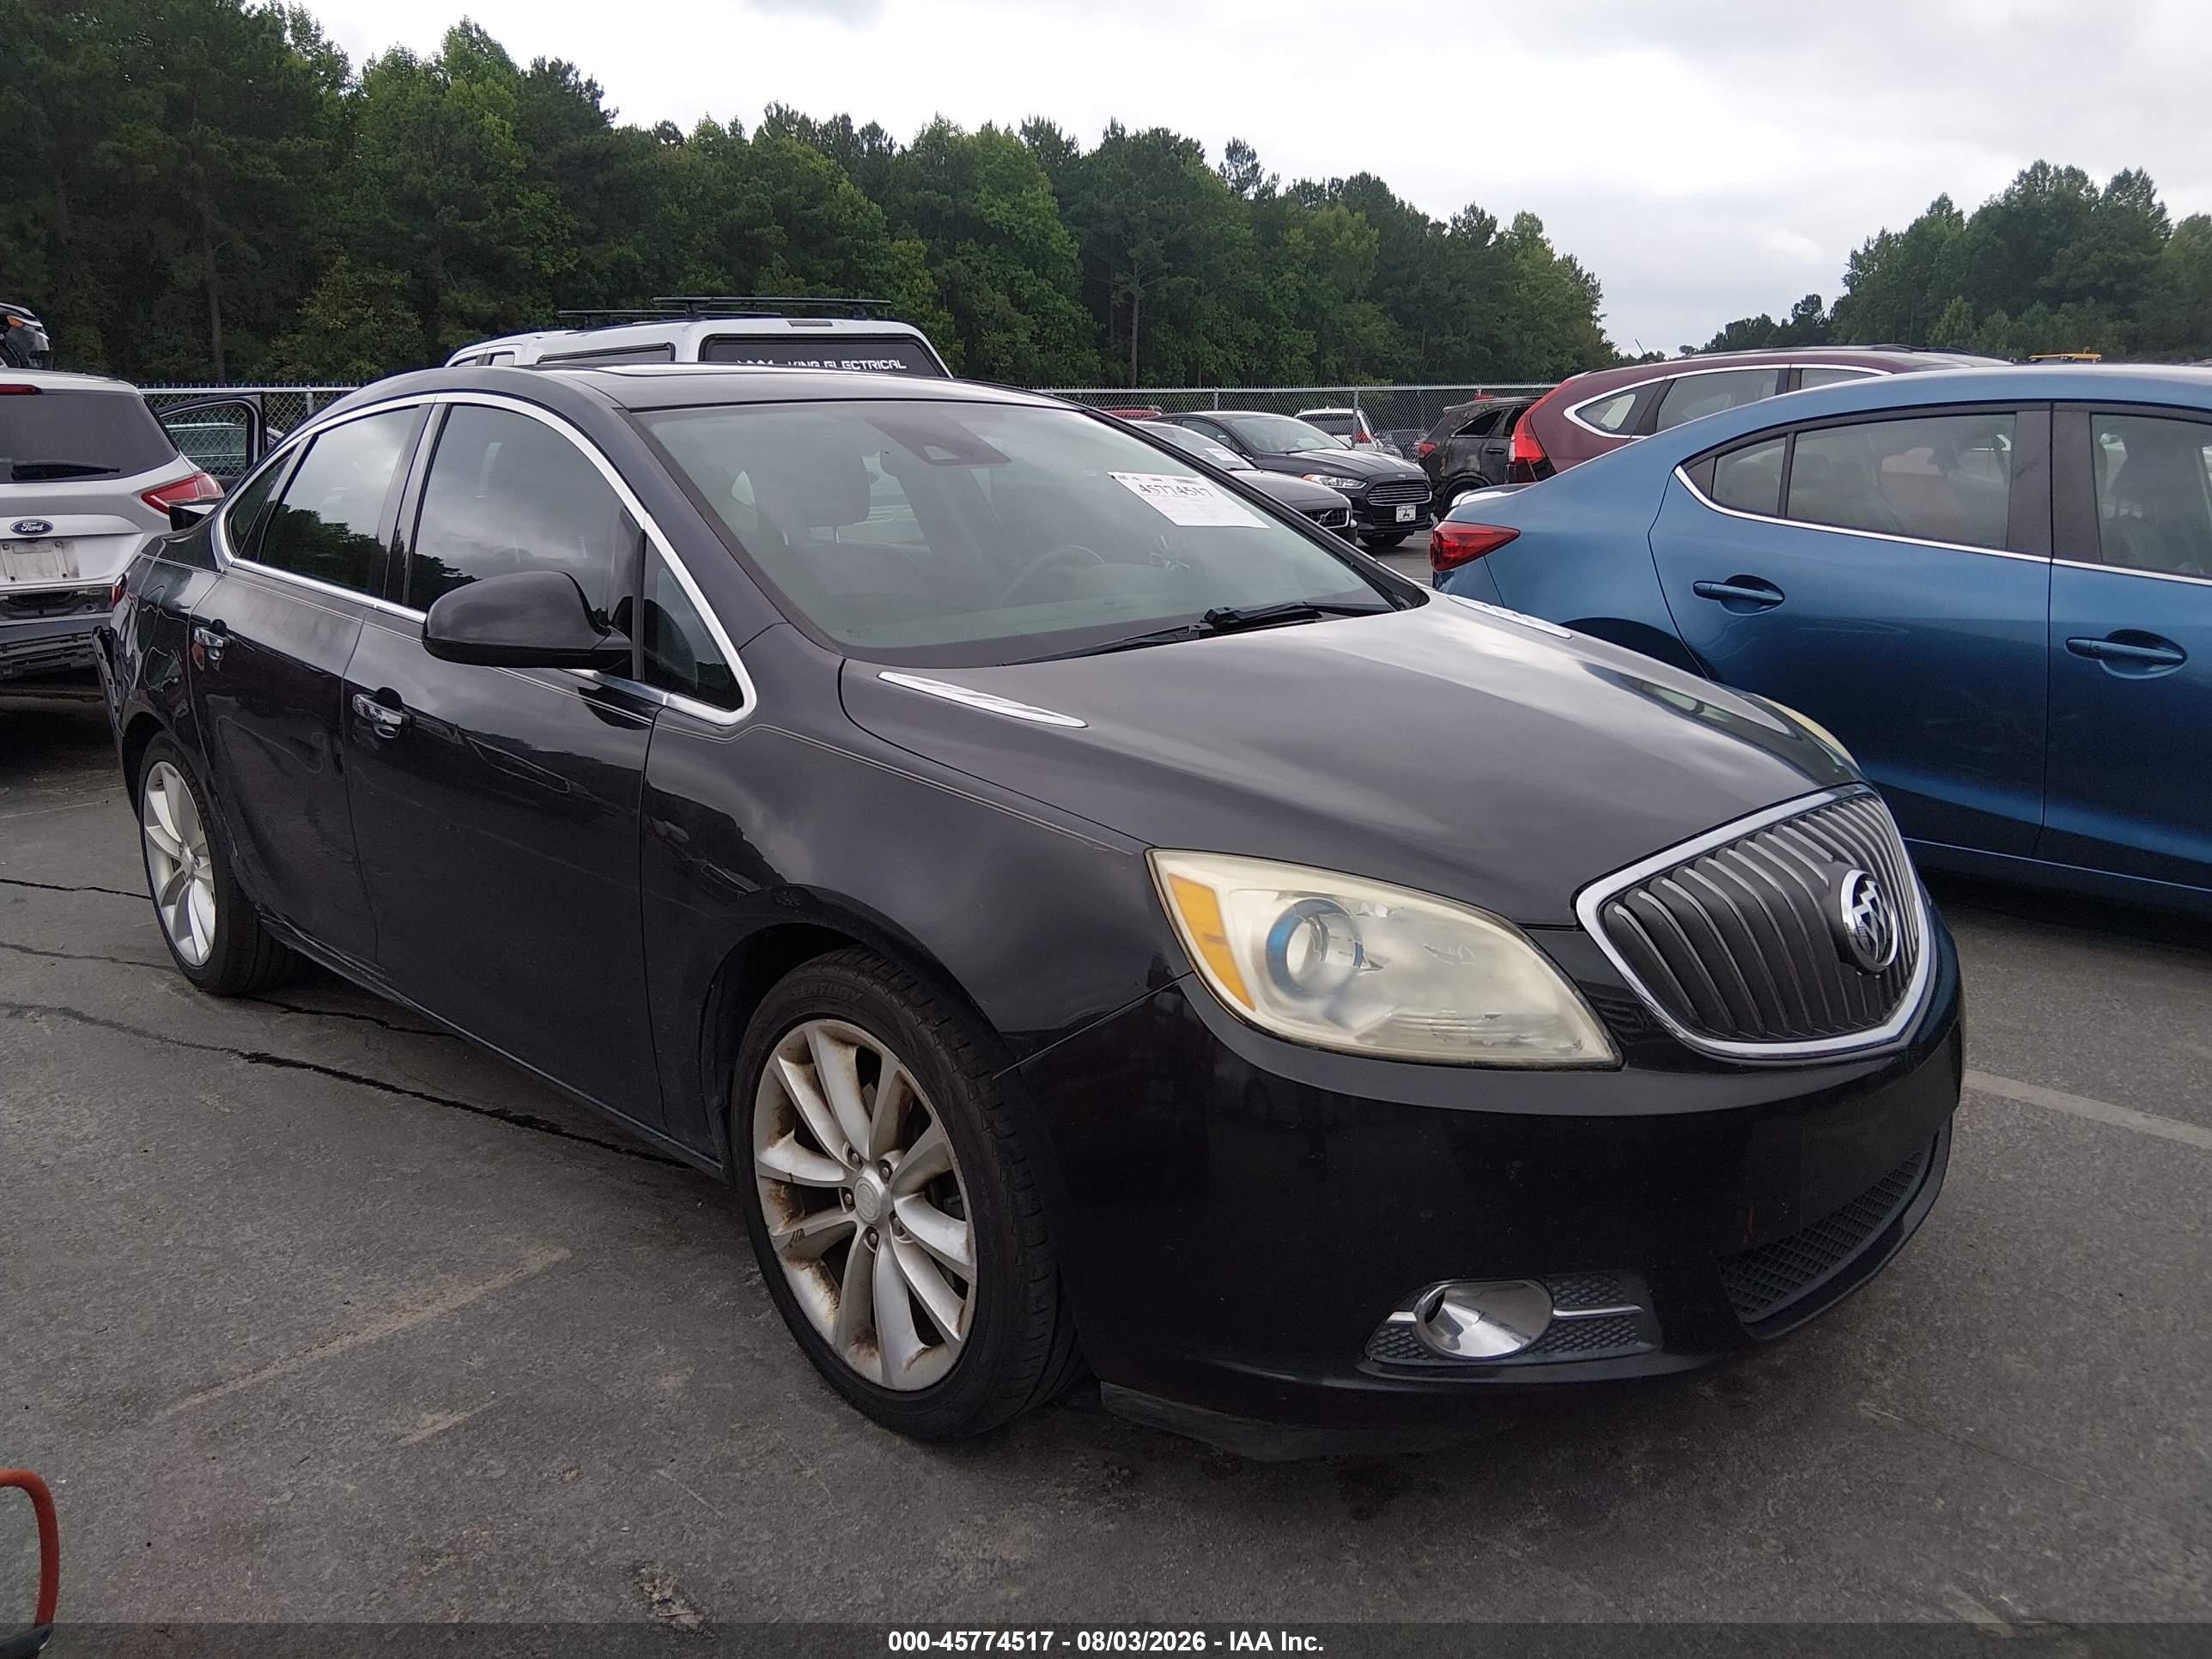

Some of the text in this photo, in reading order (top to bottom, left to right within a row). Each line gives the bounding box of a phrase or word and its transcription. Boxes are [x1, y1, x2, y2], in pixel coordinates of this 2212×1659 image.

[823, 360, 908, 369] ELECTRICAL
[1139, 483, 1214, 497] 45774517
[21, 522, 44, 531] Ford
